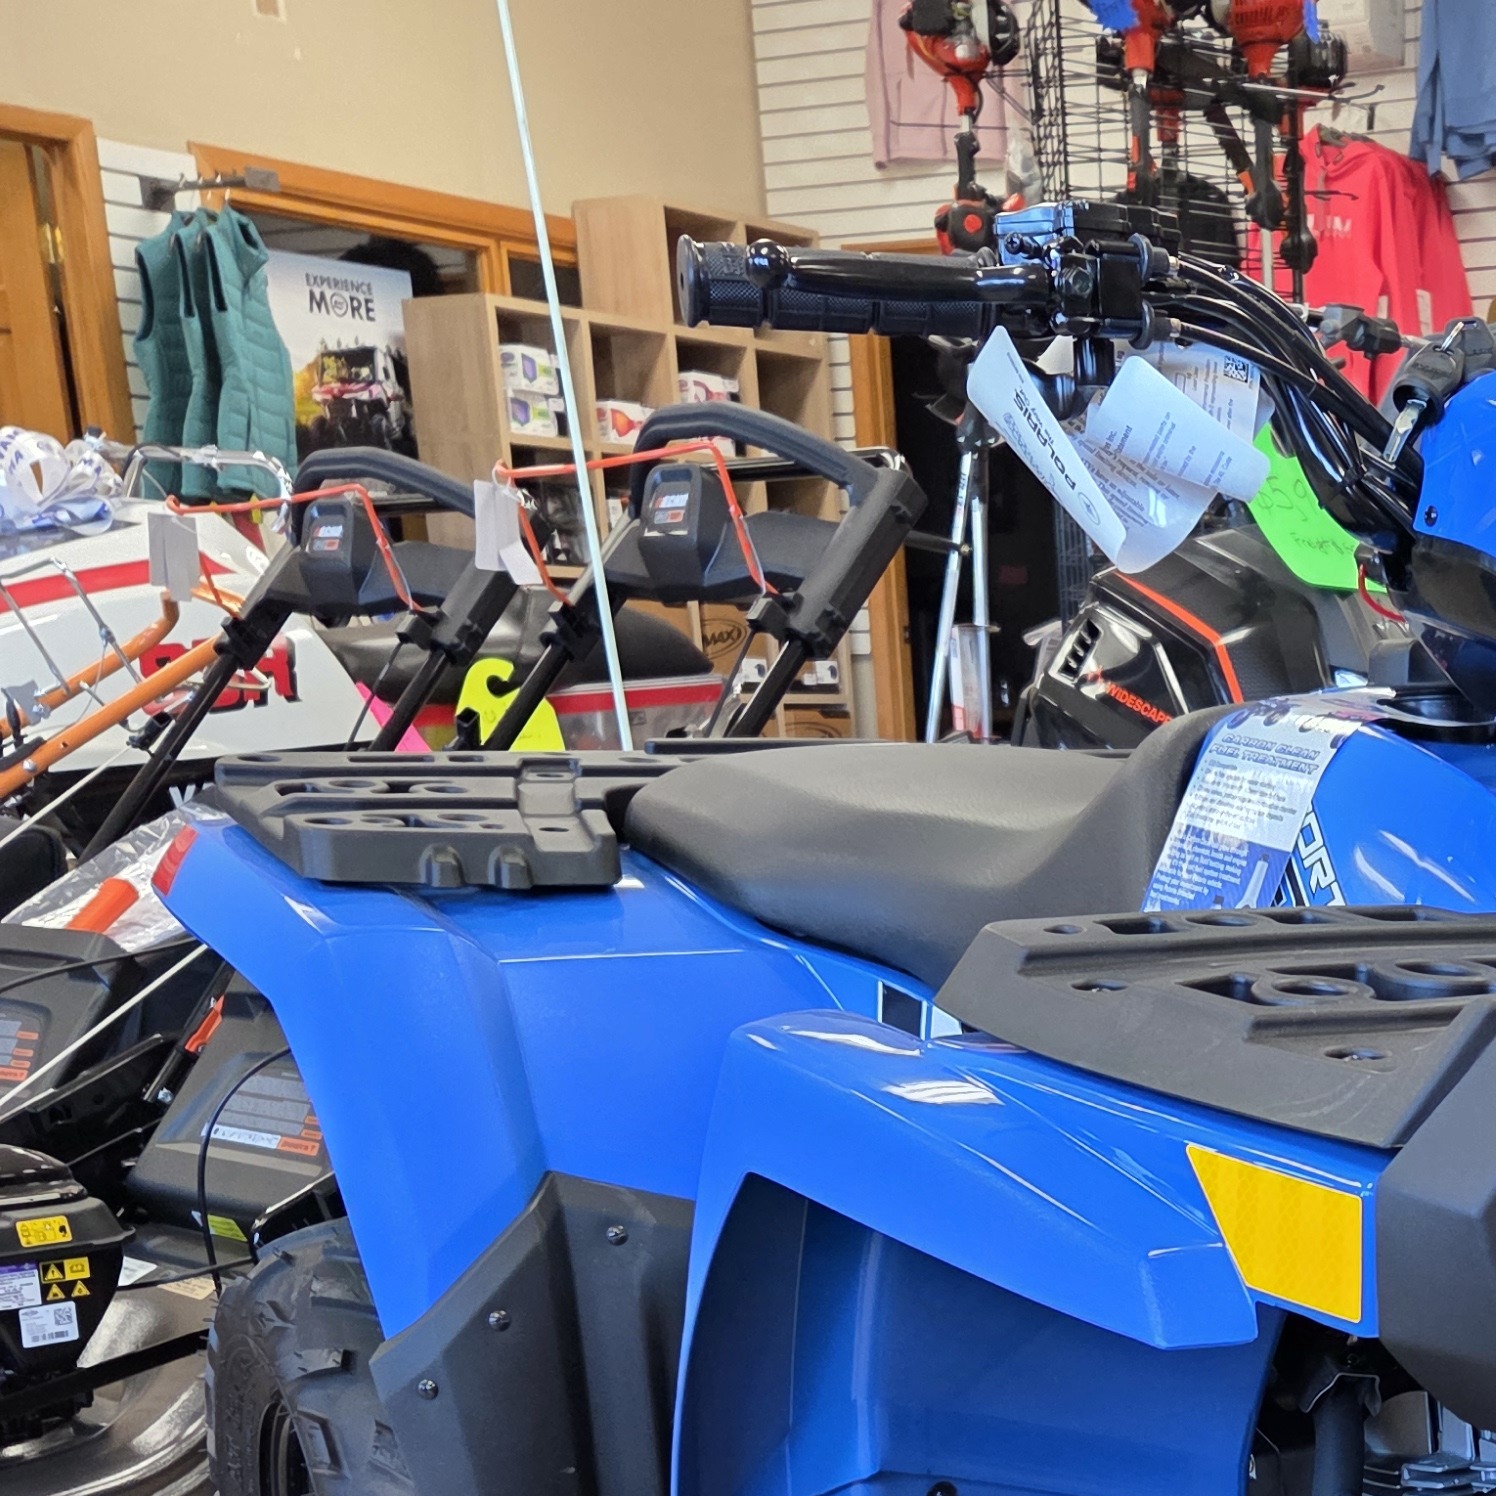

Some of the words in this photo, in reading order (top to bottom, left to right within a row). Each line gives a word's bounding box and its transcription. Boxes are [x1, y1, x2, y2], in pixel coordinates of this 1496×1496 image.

[305, 272, 373, 296] EXPERIENCE
[309, 288, 376, 322] MORE
[1012, 391, 1077, 490] POLARIS
[1106, 682, 1173, 723] WIDESCAP
[1209, 743, 1241, 759] FUEL
[1242, 749, 1319, 775] TREATMENT
[1222, 733, 1277, 751] CARBON
[1275, 743, 1320, 760] CLEAN
